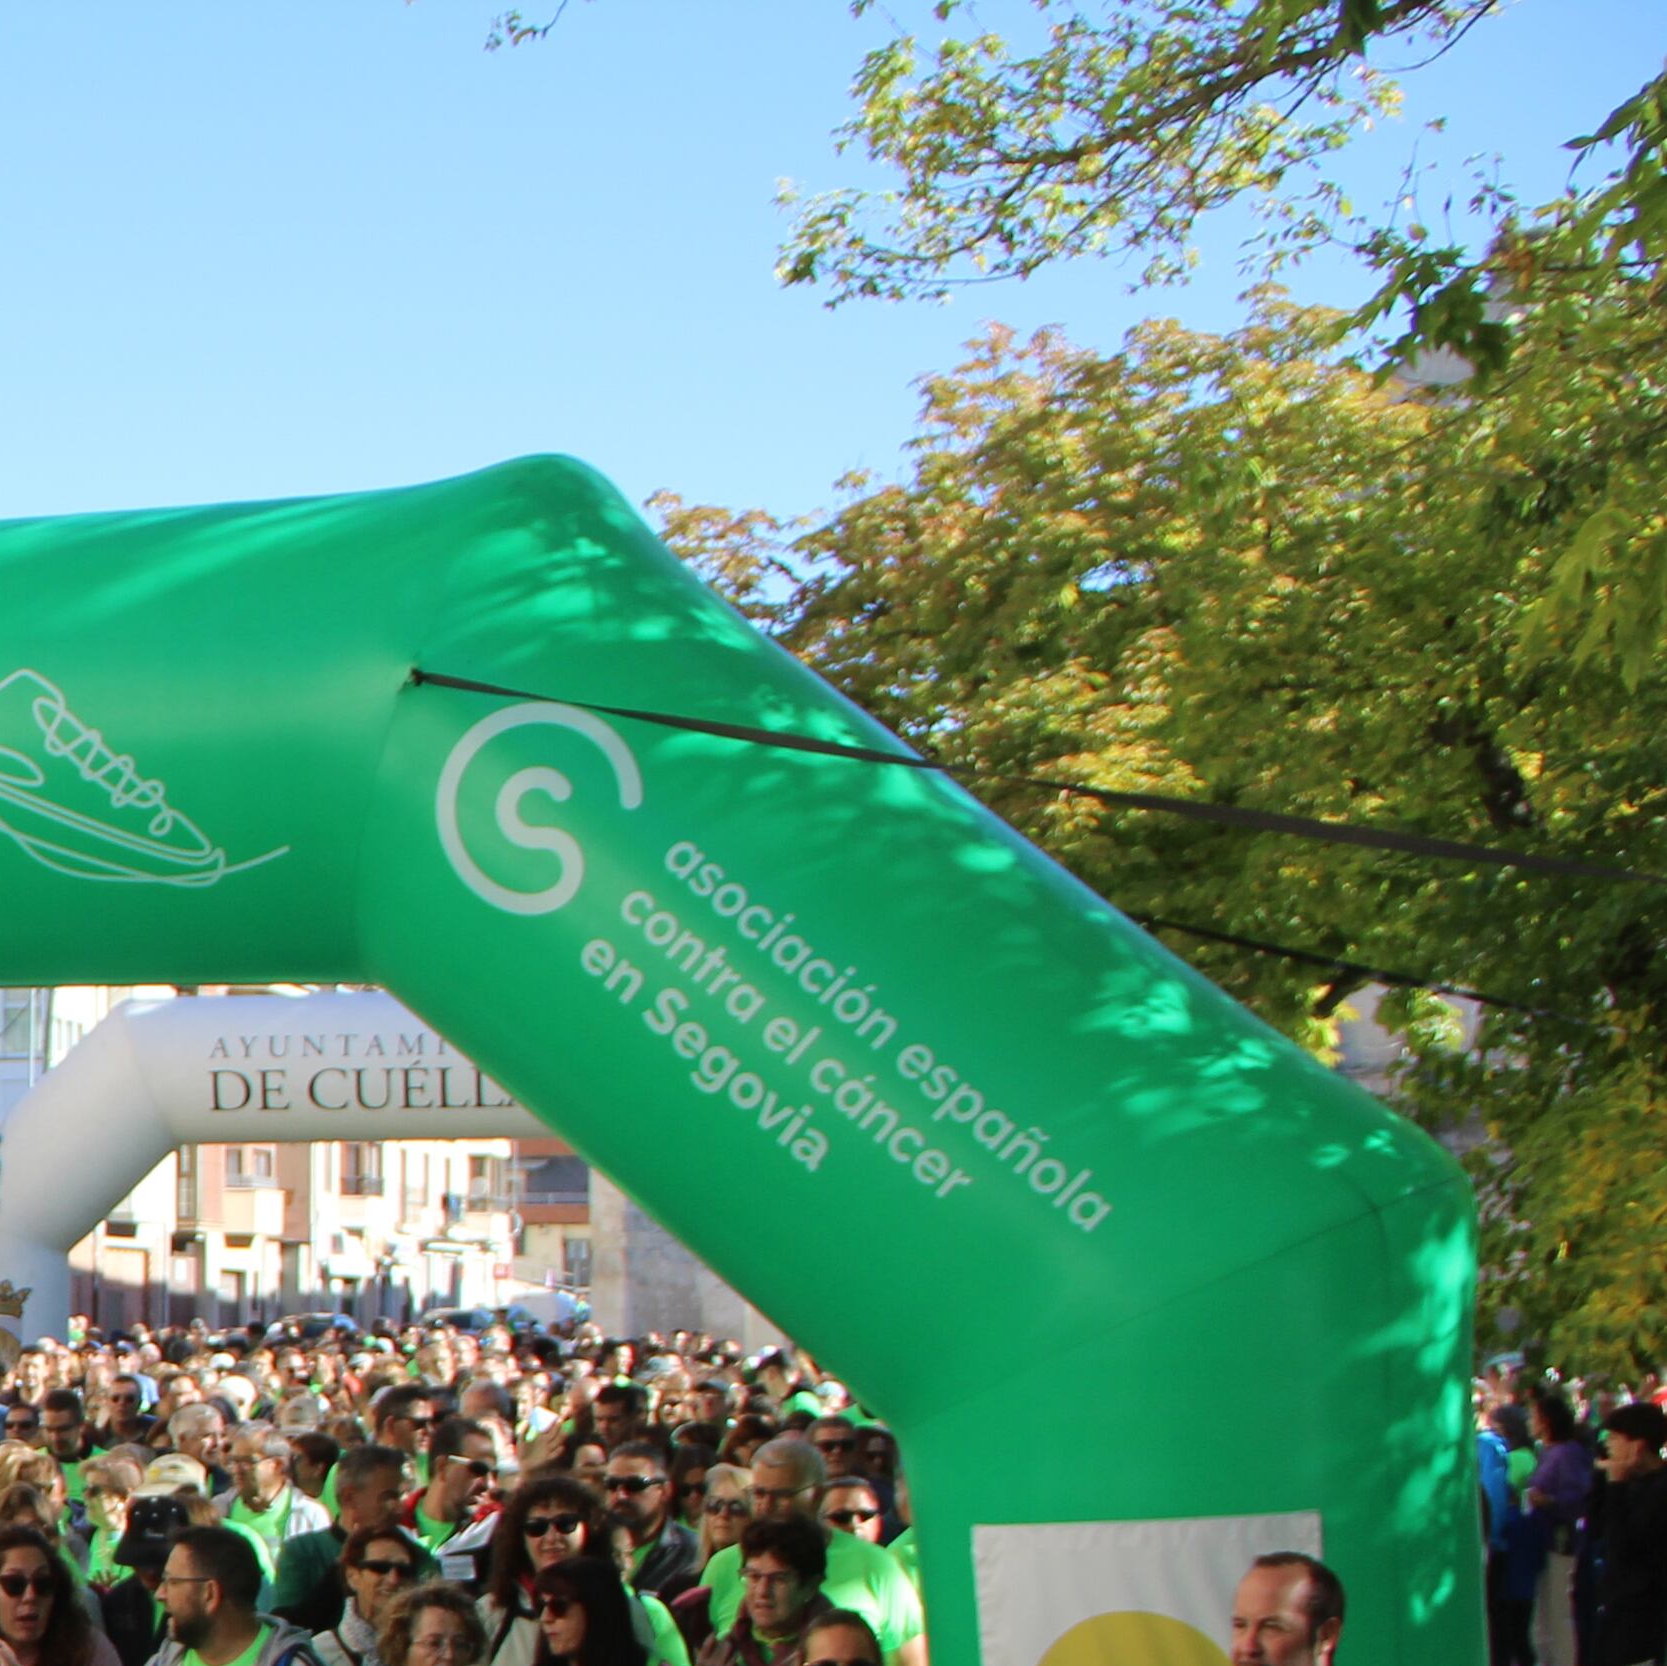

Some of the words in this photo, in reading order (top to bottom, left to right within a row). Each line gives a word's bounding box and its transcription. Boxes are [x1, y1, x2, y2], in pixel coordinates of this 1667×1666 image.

[209, 1069, 290, 1112] DE
[307, 1060, 517, 1110] CUÉLL
[579, 937, 644, 1005] en
[642, 986, 831, 1172] Segovia
[620, 888, 766, 1025] contra
[762, 1013, 821, 1067] el
[809, 1055, 973, 1199] cáncer
[665, 839, 899, 1051] asociación
[896, 1042, 1112, 1234] española
